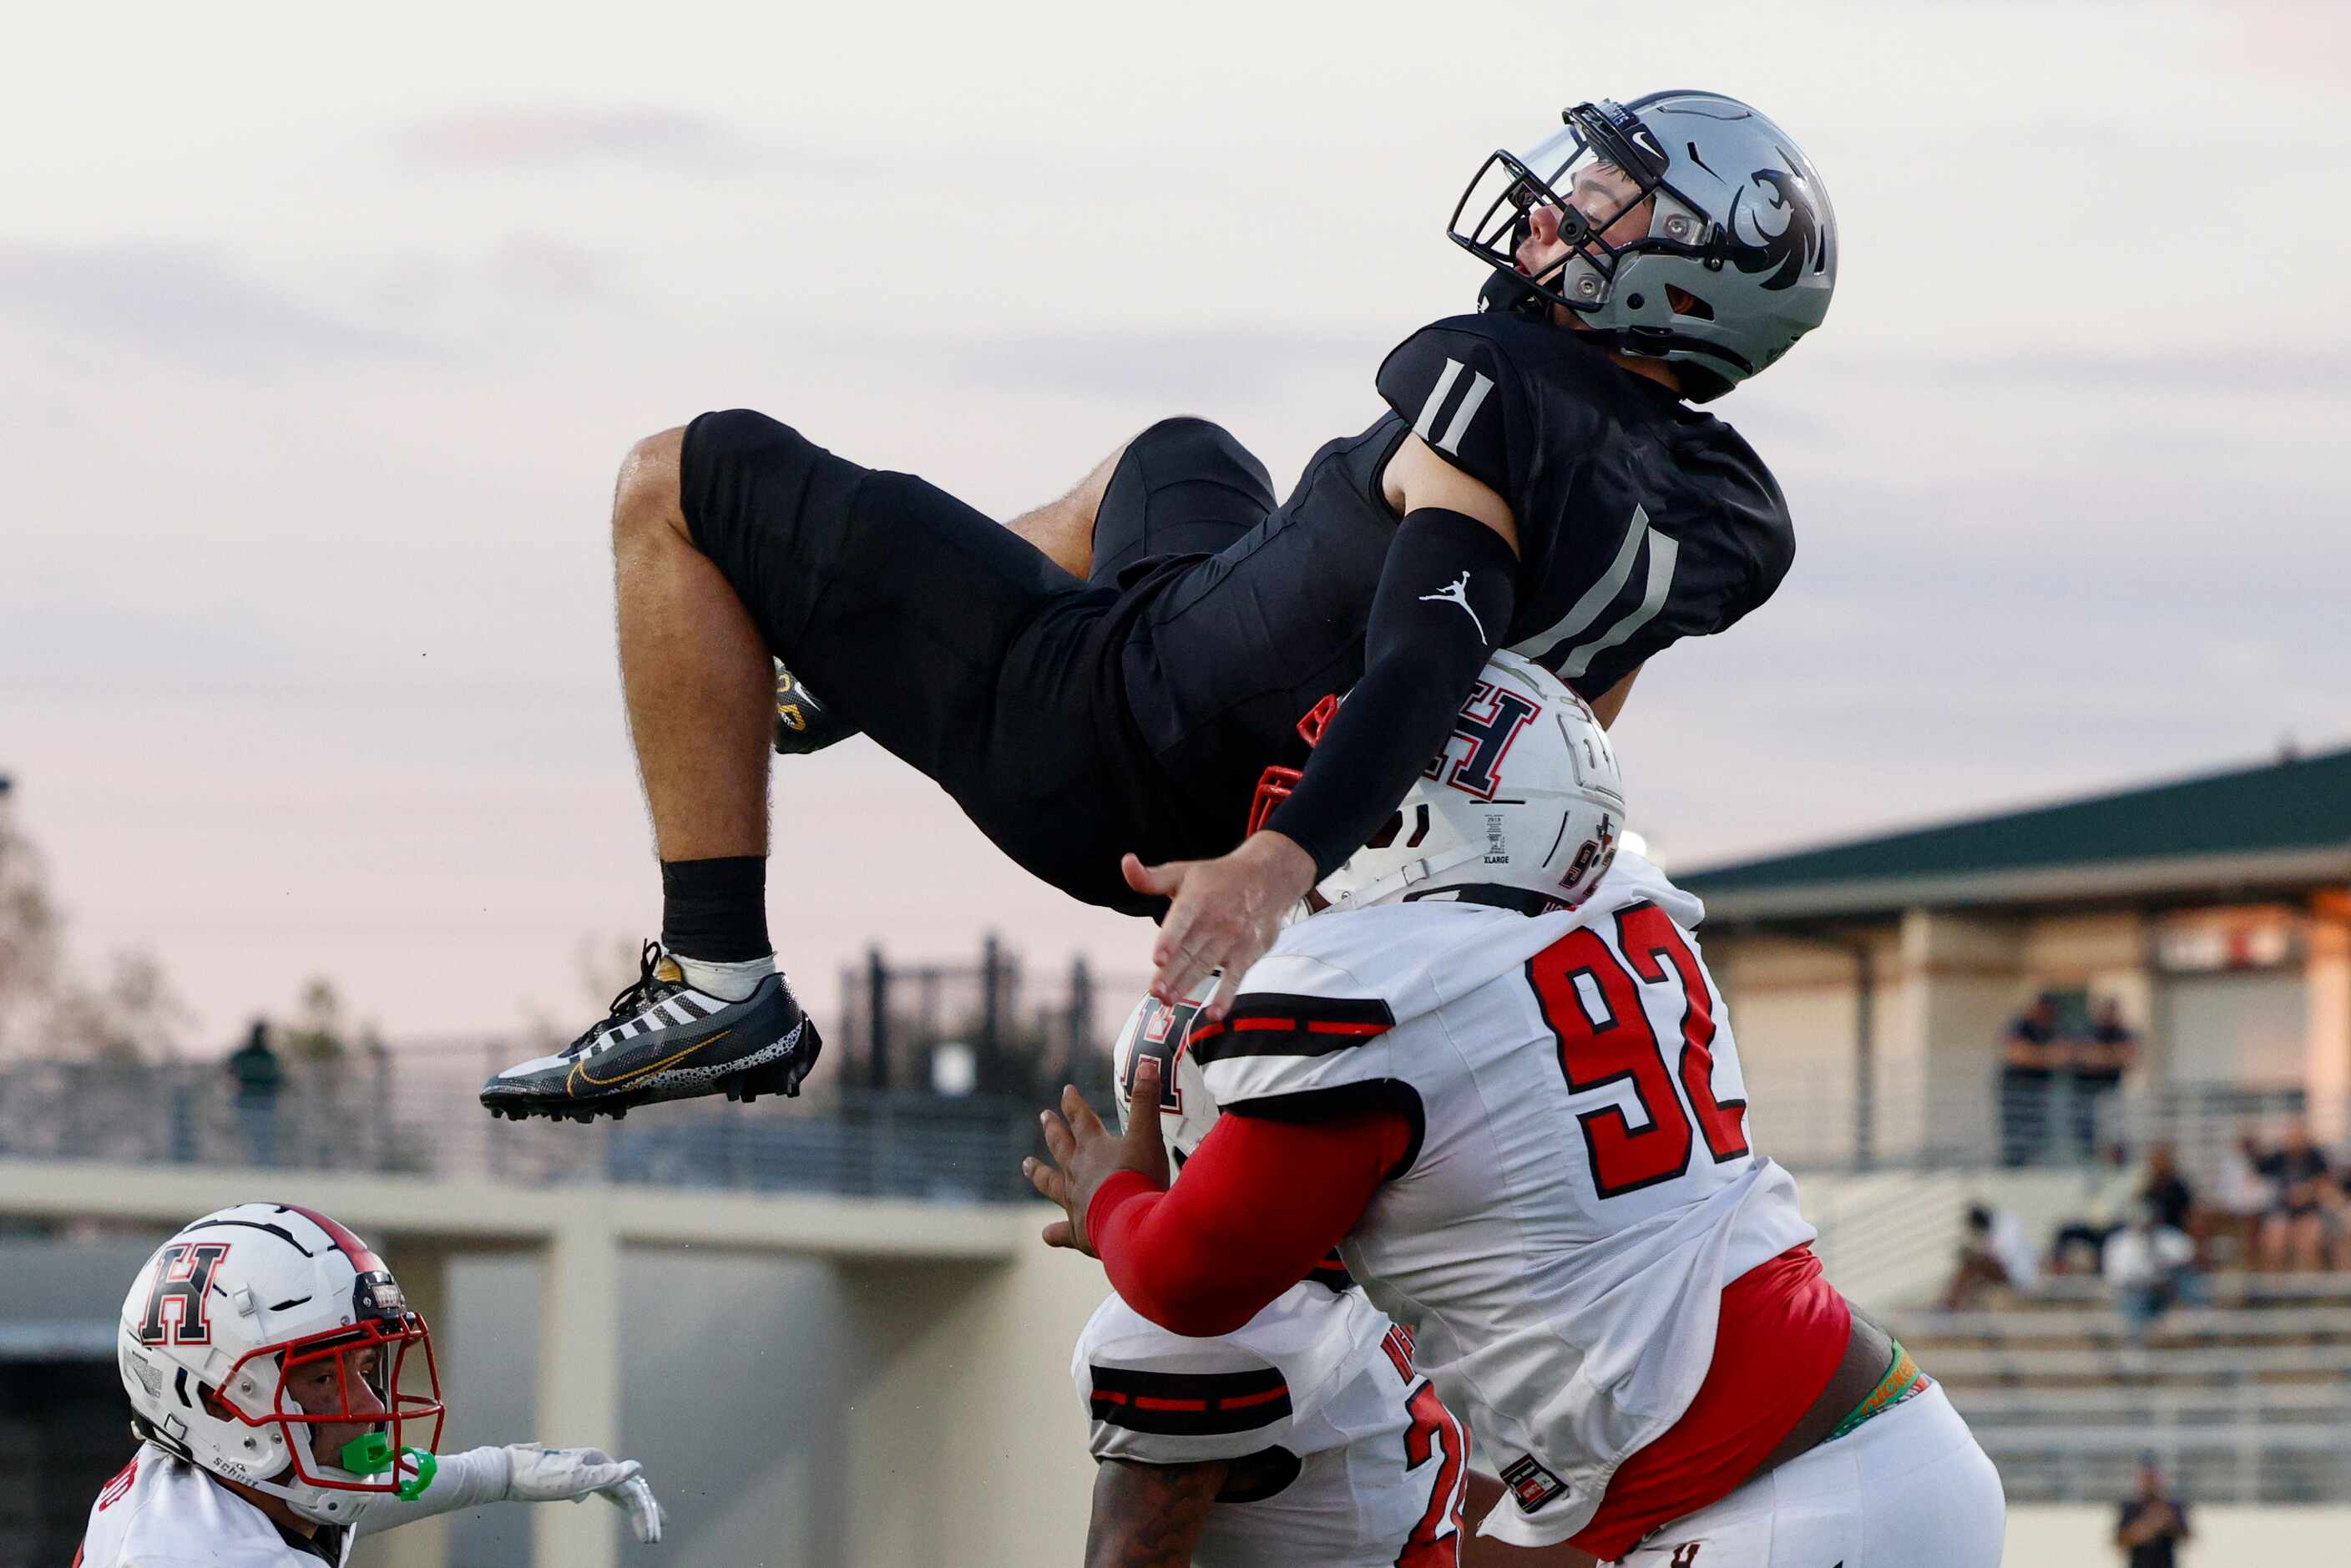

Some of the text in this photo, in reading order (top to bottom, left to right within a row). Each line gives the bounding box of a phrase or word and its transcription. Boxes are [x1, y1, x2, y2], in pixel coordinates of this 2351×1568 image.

[1413, 357, 1494, 456] 11
[1508, 503, 1679, 678] 11
[1423, 680, 1543, 802] H
[1484, 855, 1509, 864] XLARGE
[1120, 997, 1202, 1115] H
[1524, 899, 1749, 1201] 92
[138, 1242, 231, 1347] H
